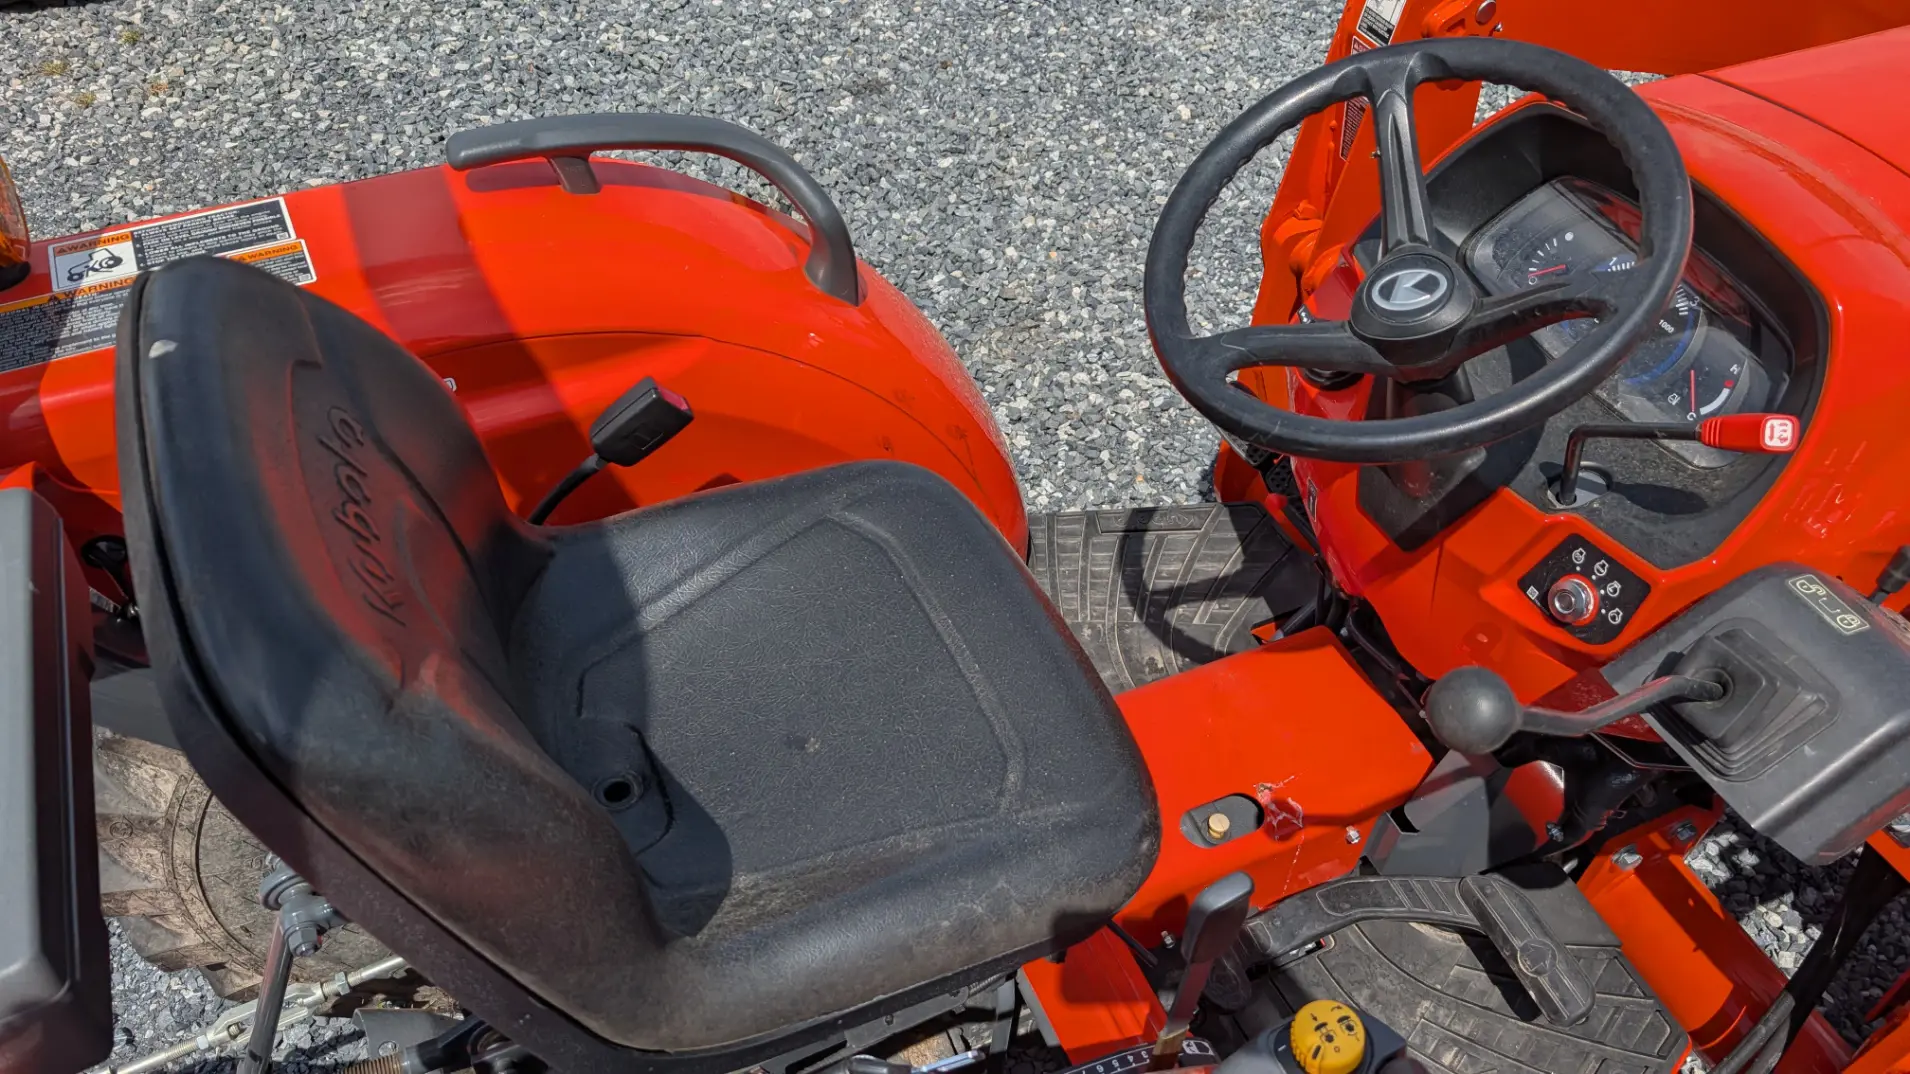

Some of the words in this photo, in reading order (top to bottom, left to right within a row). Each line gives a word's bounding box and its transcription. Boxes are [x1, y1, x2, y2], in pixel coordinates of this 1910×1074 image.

[66, 234, 130, 250] WARNING
[248, 244, 298, 259] WARNING
[1690, 295, 1700, 307] 3
[1658, 319, 1675, 334] 1000
[316, 405, 406, 627] Kubota
